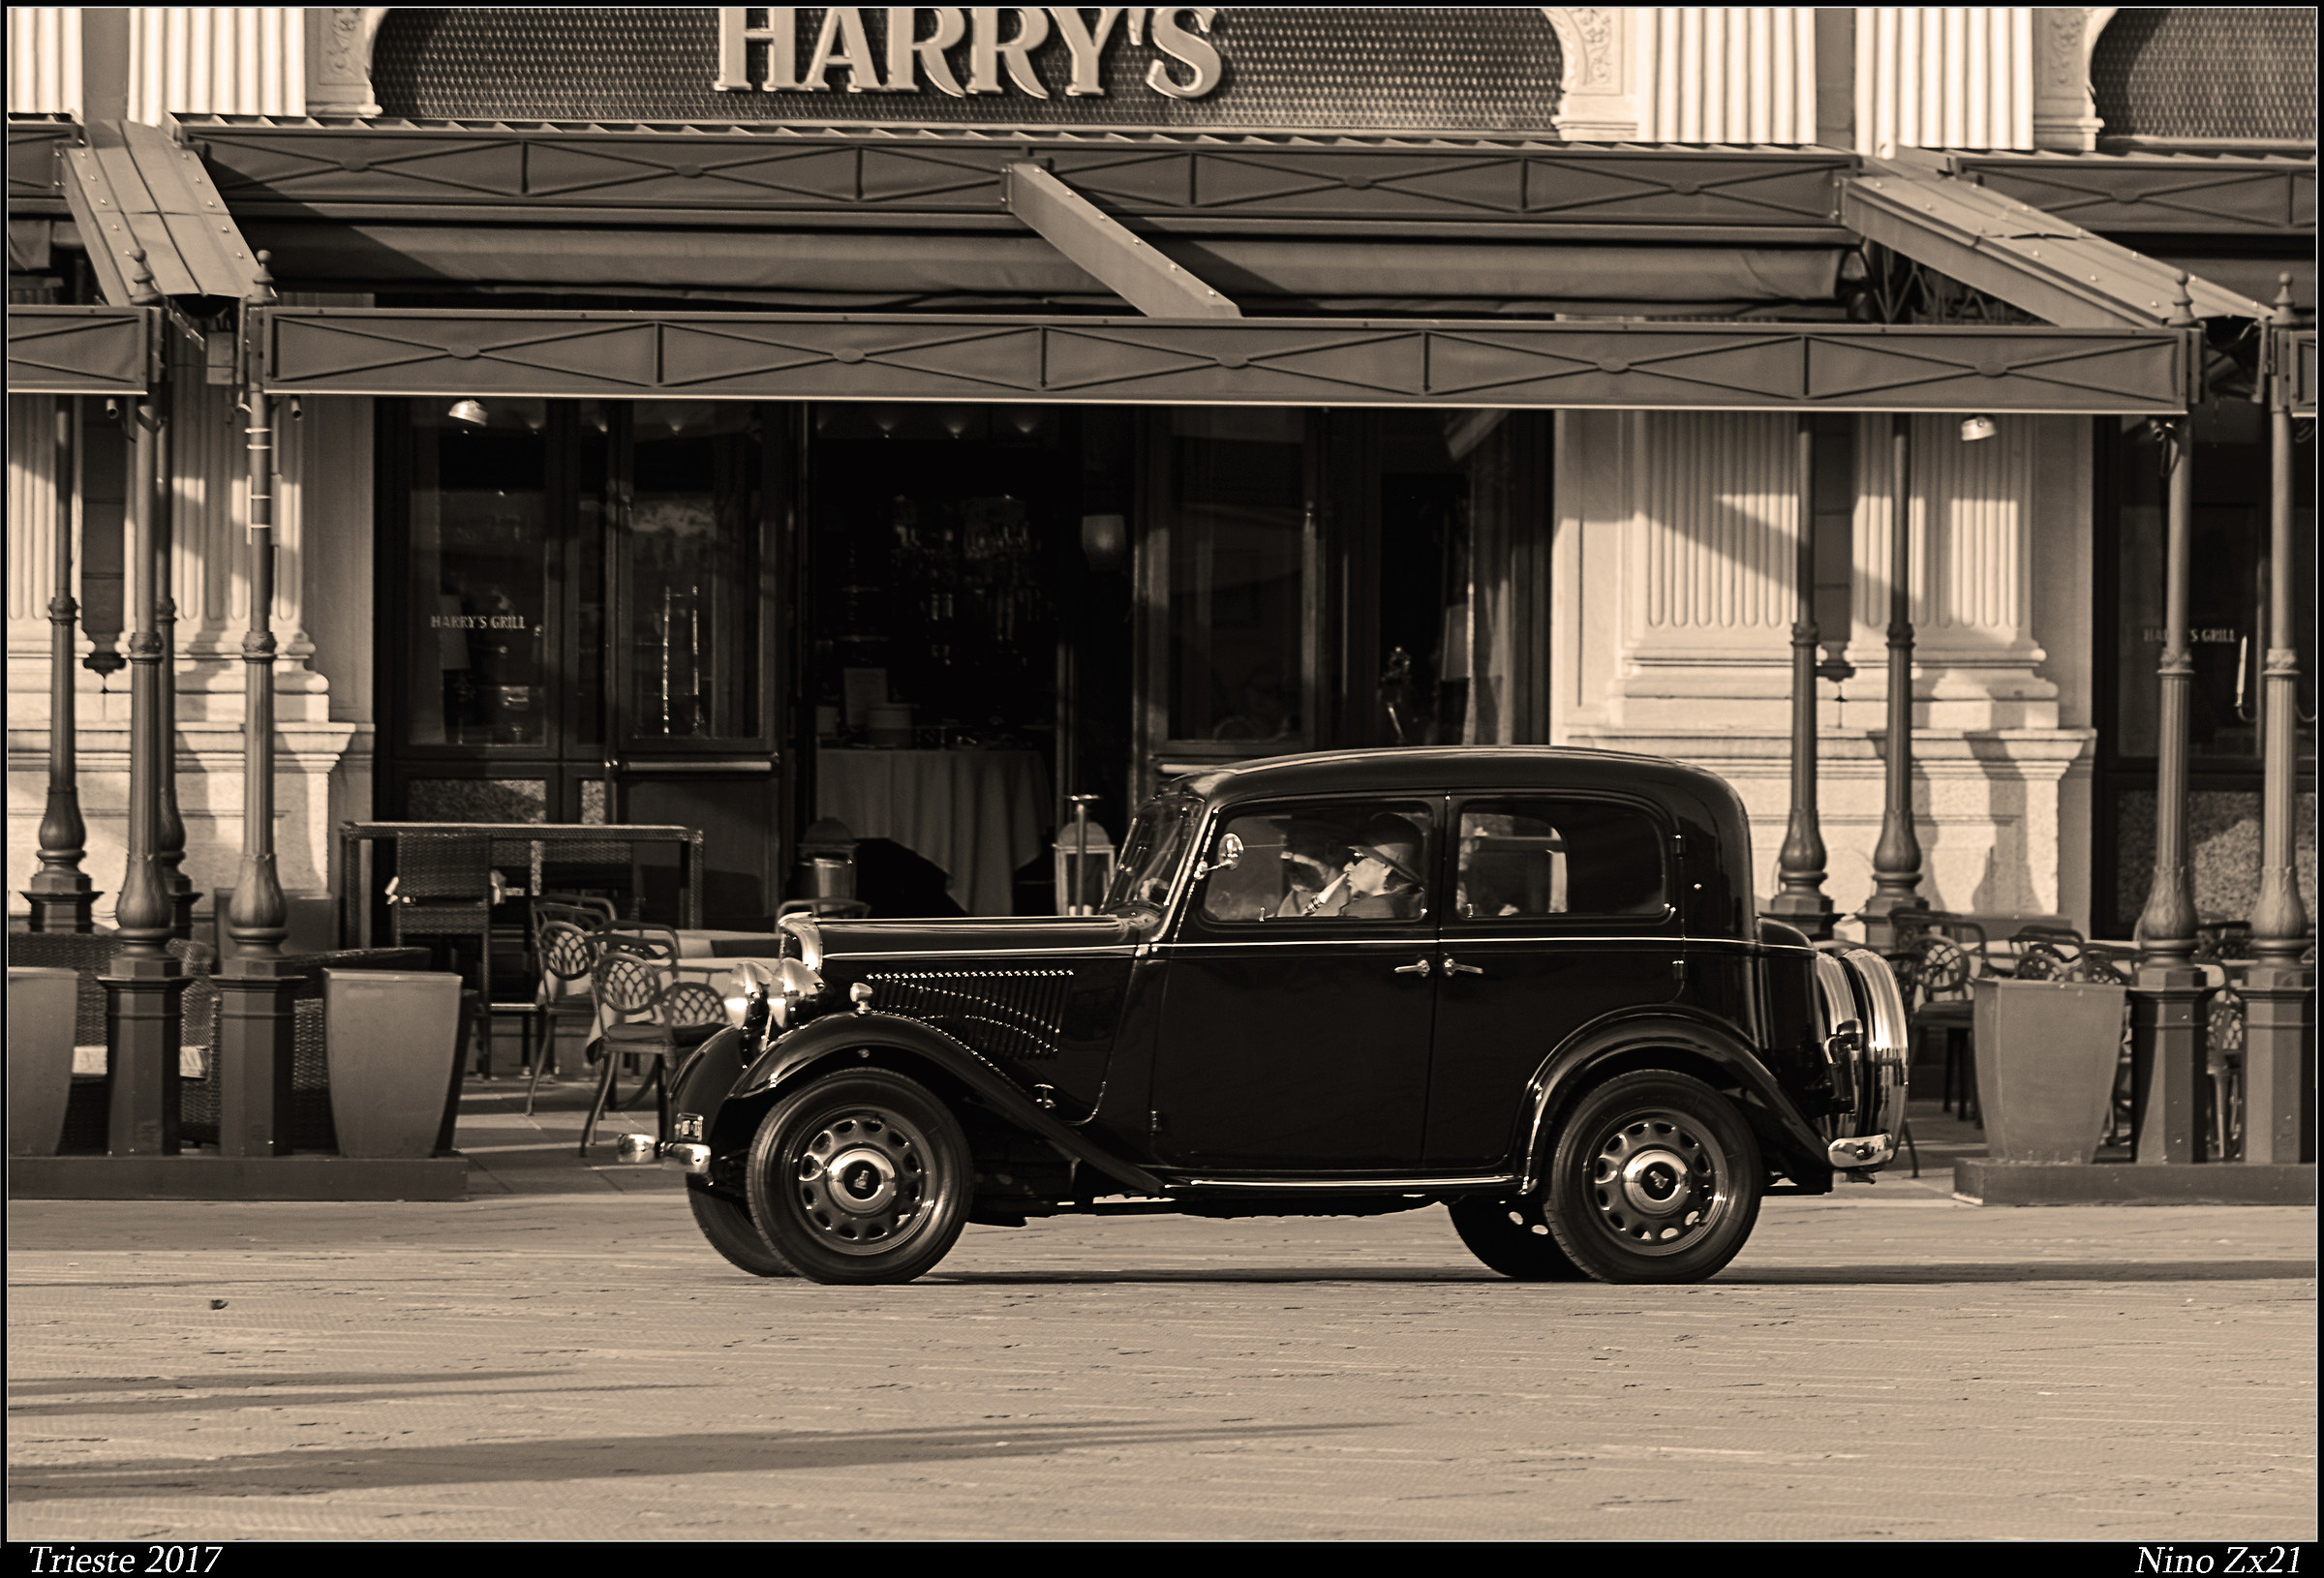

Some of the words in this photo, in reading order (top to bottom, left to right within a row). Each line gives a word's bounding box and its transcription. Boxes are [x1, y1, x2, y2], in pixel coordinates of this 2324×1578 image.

[714, 8, 1222, 98] HARRY'S
[430, 616, 487, 629] HARRY'S
[490, 616, 526, 629] GRILL
